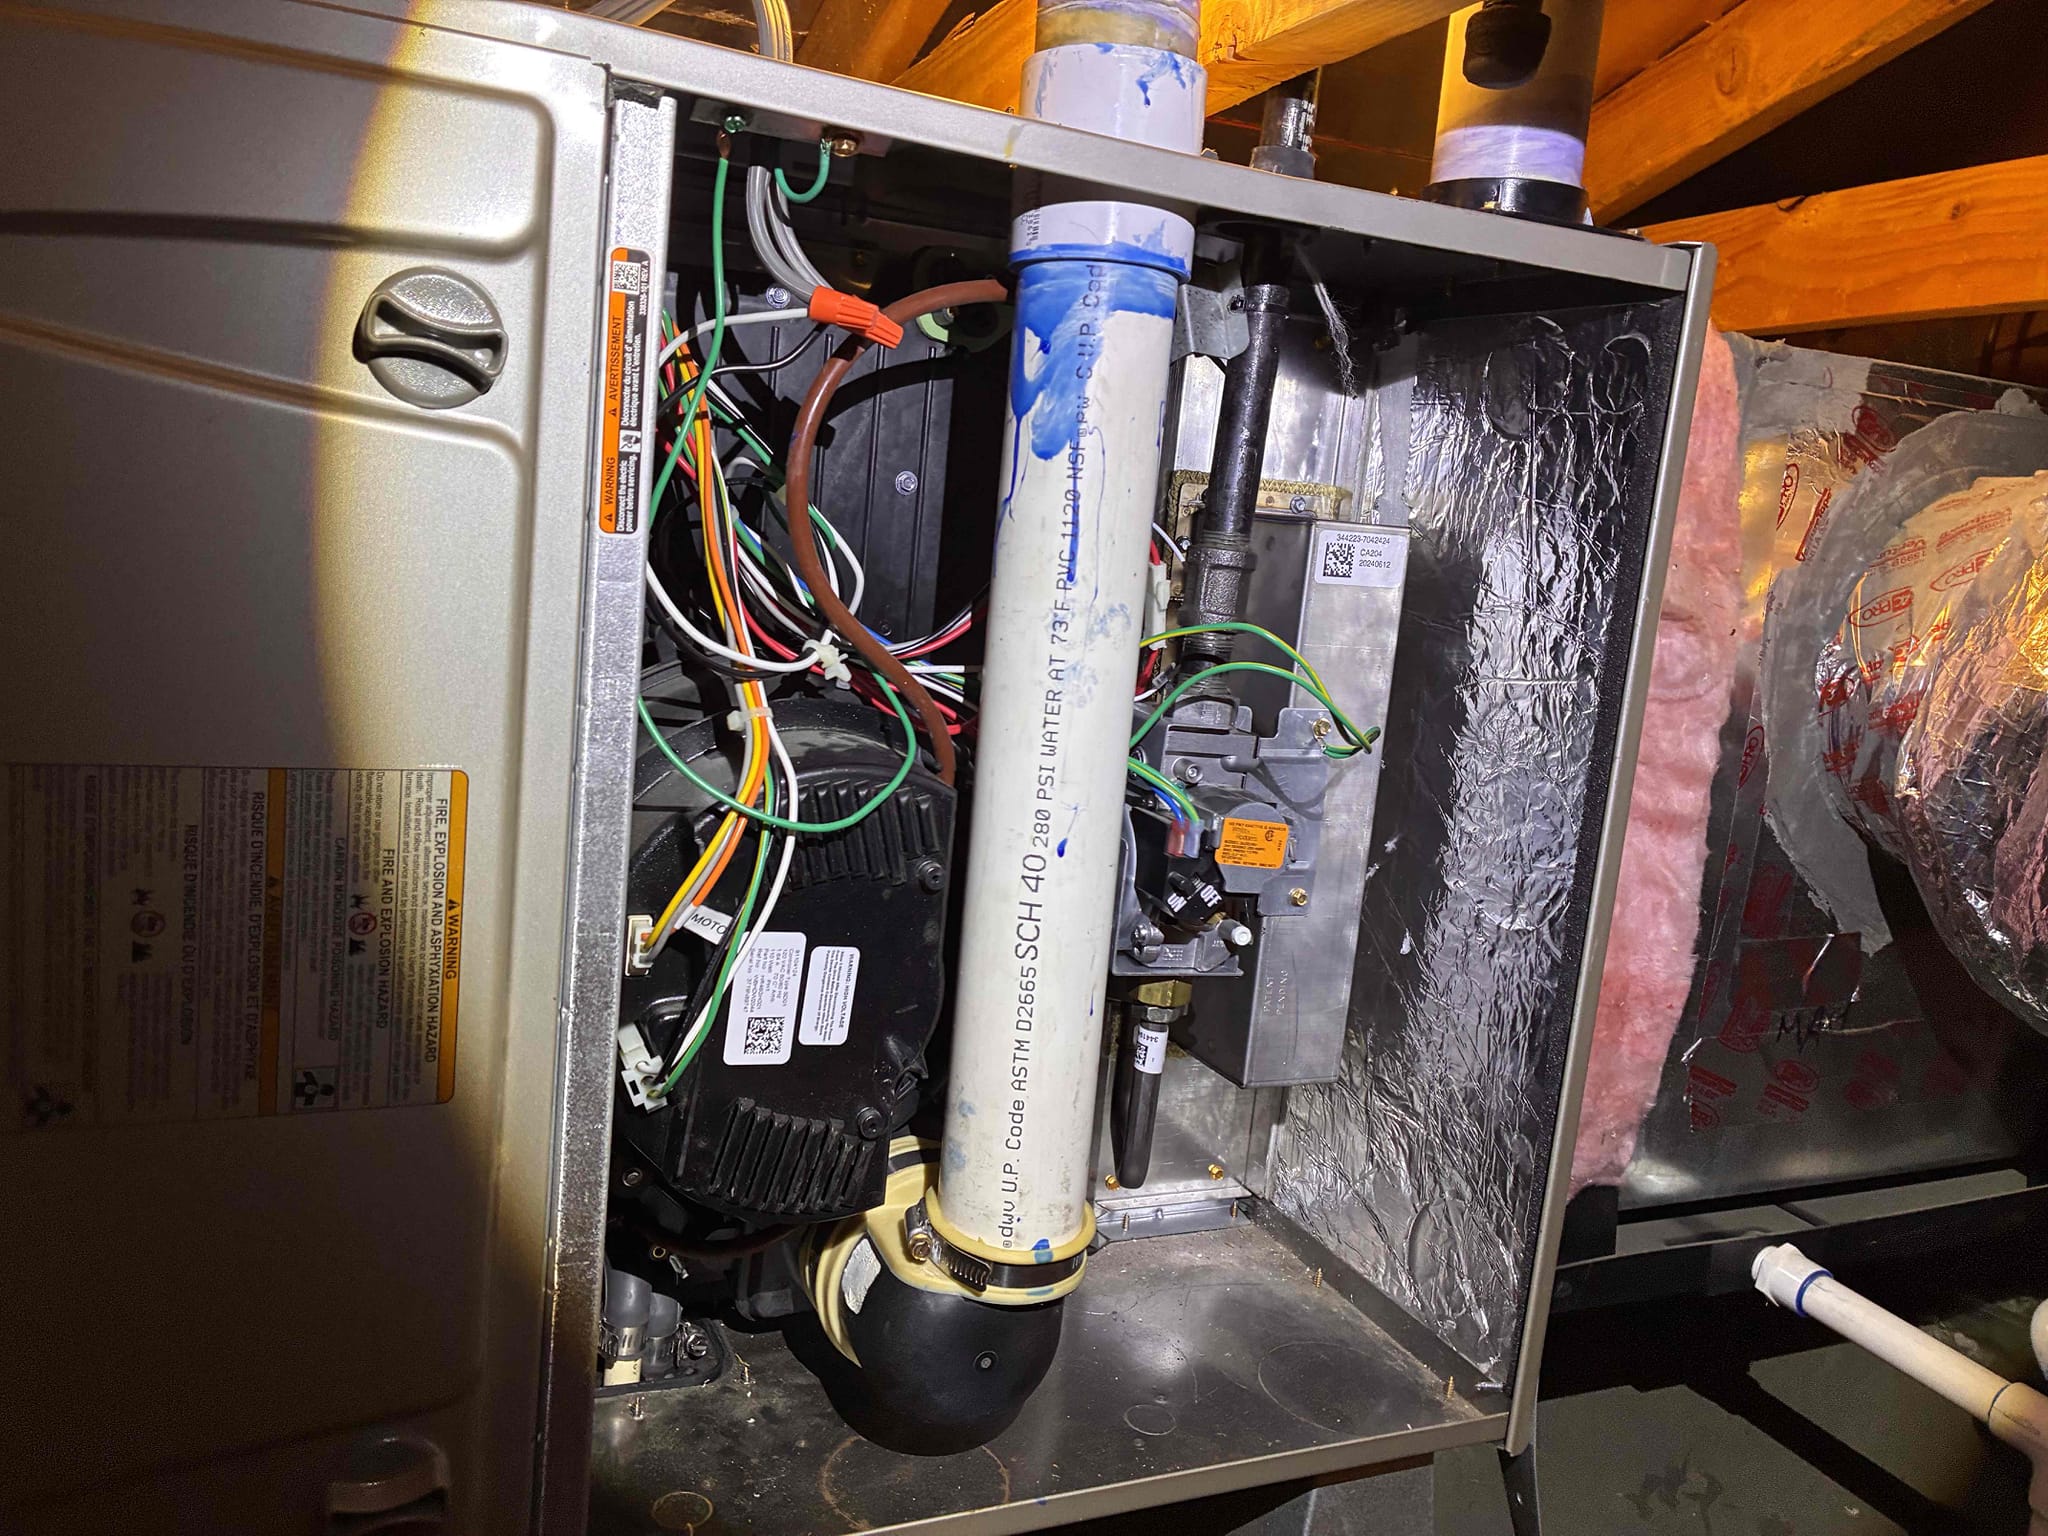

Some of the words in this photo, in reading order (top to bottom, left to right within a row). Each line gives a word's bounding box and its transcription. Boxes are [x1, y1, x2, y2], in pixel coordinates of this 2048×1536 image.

[640, 265, 649, 282] REV.
[626, 301, 635, 343] alimentation
[609, 315, 622, 401] AVERTISSEMENT
[624, 375, 631, 384] du
[620, 386, 631, 426] Déconnecter
[605, 457, 616, 505] WARNING
[618, 460, 627, 483] electric
[627, 453, 637, 486] servicing.
[617, 485, 626, 494] the
[625, 488, 635, 509] before
[616, 495, 626, 532] Disconnect
[625, 511, 635, 531] power
[1061, 489, 1080, 538] 1120
[1336, 533, 1391, 545] 344223-7042424
[1360, 548, 1383, 558] CA204
[1056, 550, 1072, 591] PVC
[1358, 559, 1391, 569] 20240612
[1048, 654, 1065, 681] AT
[1040, 690, 1062, 756] WATER
[376, 783, 384, 793] not
[377, 772, 385, 781] Do
[425, 772, 434, 802] Improper
[1036, 765, 1055, 800] PSI
[251, 792, 265, 836] RISQUE
[403, 802, 412, 839] Installation
[414, 798, 423, 816] Read
[434, 798, 448, 829] FIRE,
[414, 818, 422, 831] and
[1032, 809, 1050, 848] 280
[403, 840, 411, 853] and
[413, 832, 422, 852] follow
[334, 838, 345, 881] CARBON
[382, 849, 395, 875] FIRE
[411, 854, 421, 892] instructions
[433, 832, 447, 898] EXPLOSION
[1021, 854, 1046, 892] 40
[381, 880, 393, 905] AND
[411, 894, 419, 907] and
[1200, 884, 1222, 908] OFF
[431, 902, 444, 926] AND
[1015, 901, 1042, 960] SCH
[379, 908, 392, 976] EXPLOSION
[446, 914, 459, 980] WARNING
[427, 929, 443, 1012] ASPHYXIATION
[783, 977, 791, 990] Type
[845, 953, 854, 984] WARNING:
[376, 980, 389, 1029] HAZARD
[1016, 966, 1036, 1031] D2665
[1263, 976, 1274, 1013] PATENT
[838, 1001, 848, 1028] VOLTAGE
[425, 1016, 437, 1063] HAZARD
[1011, 1039, 1030, 1091] ASTM
[1006, 1099, 1025, 1150] Code
[1001, 1159, 1020, 1193] U.P.
[998, 1200, 1015, 1238] dwv
